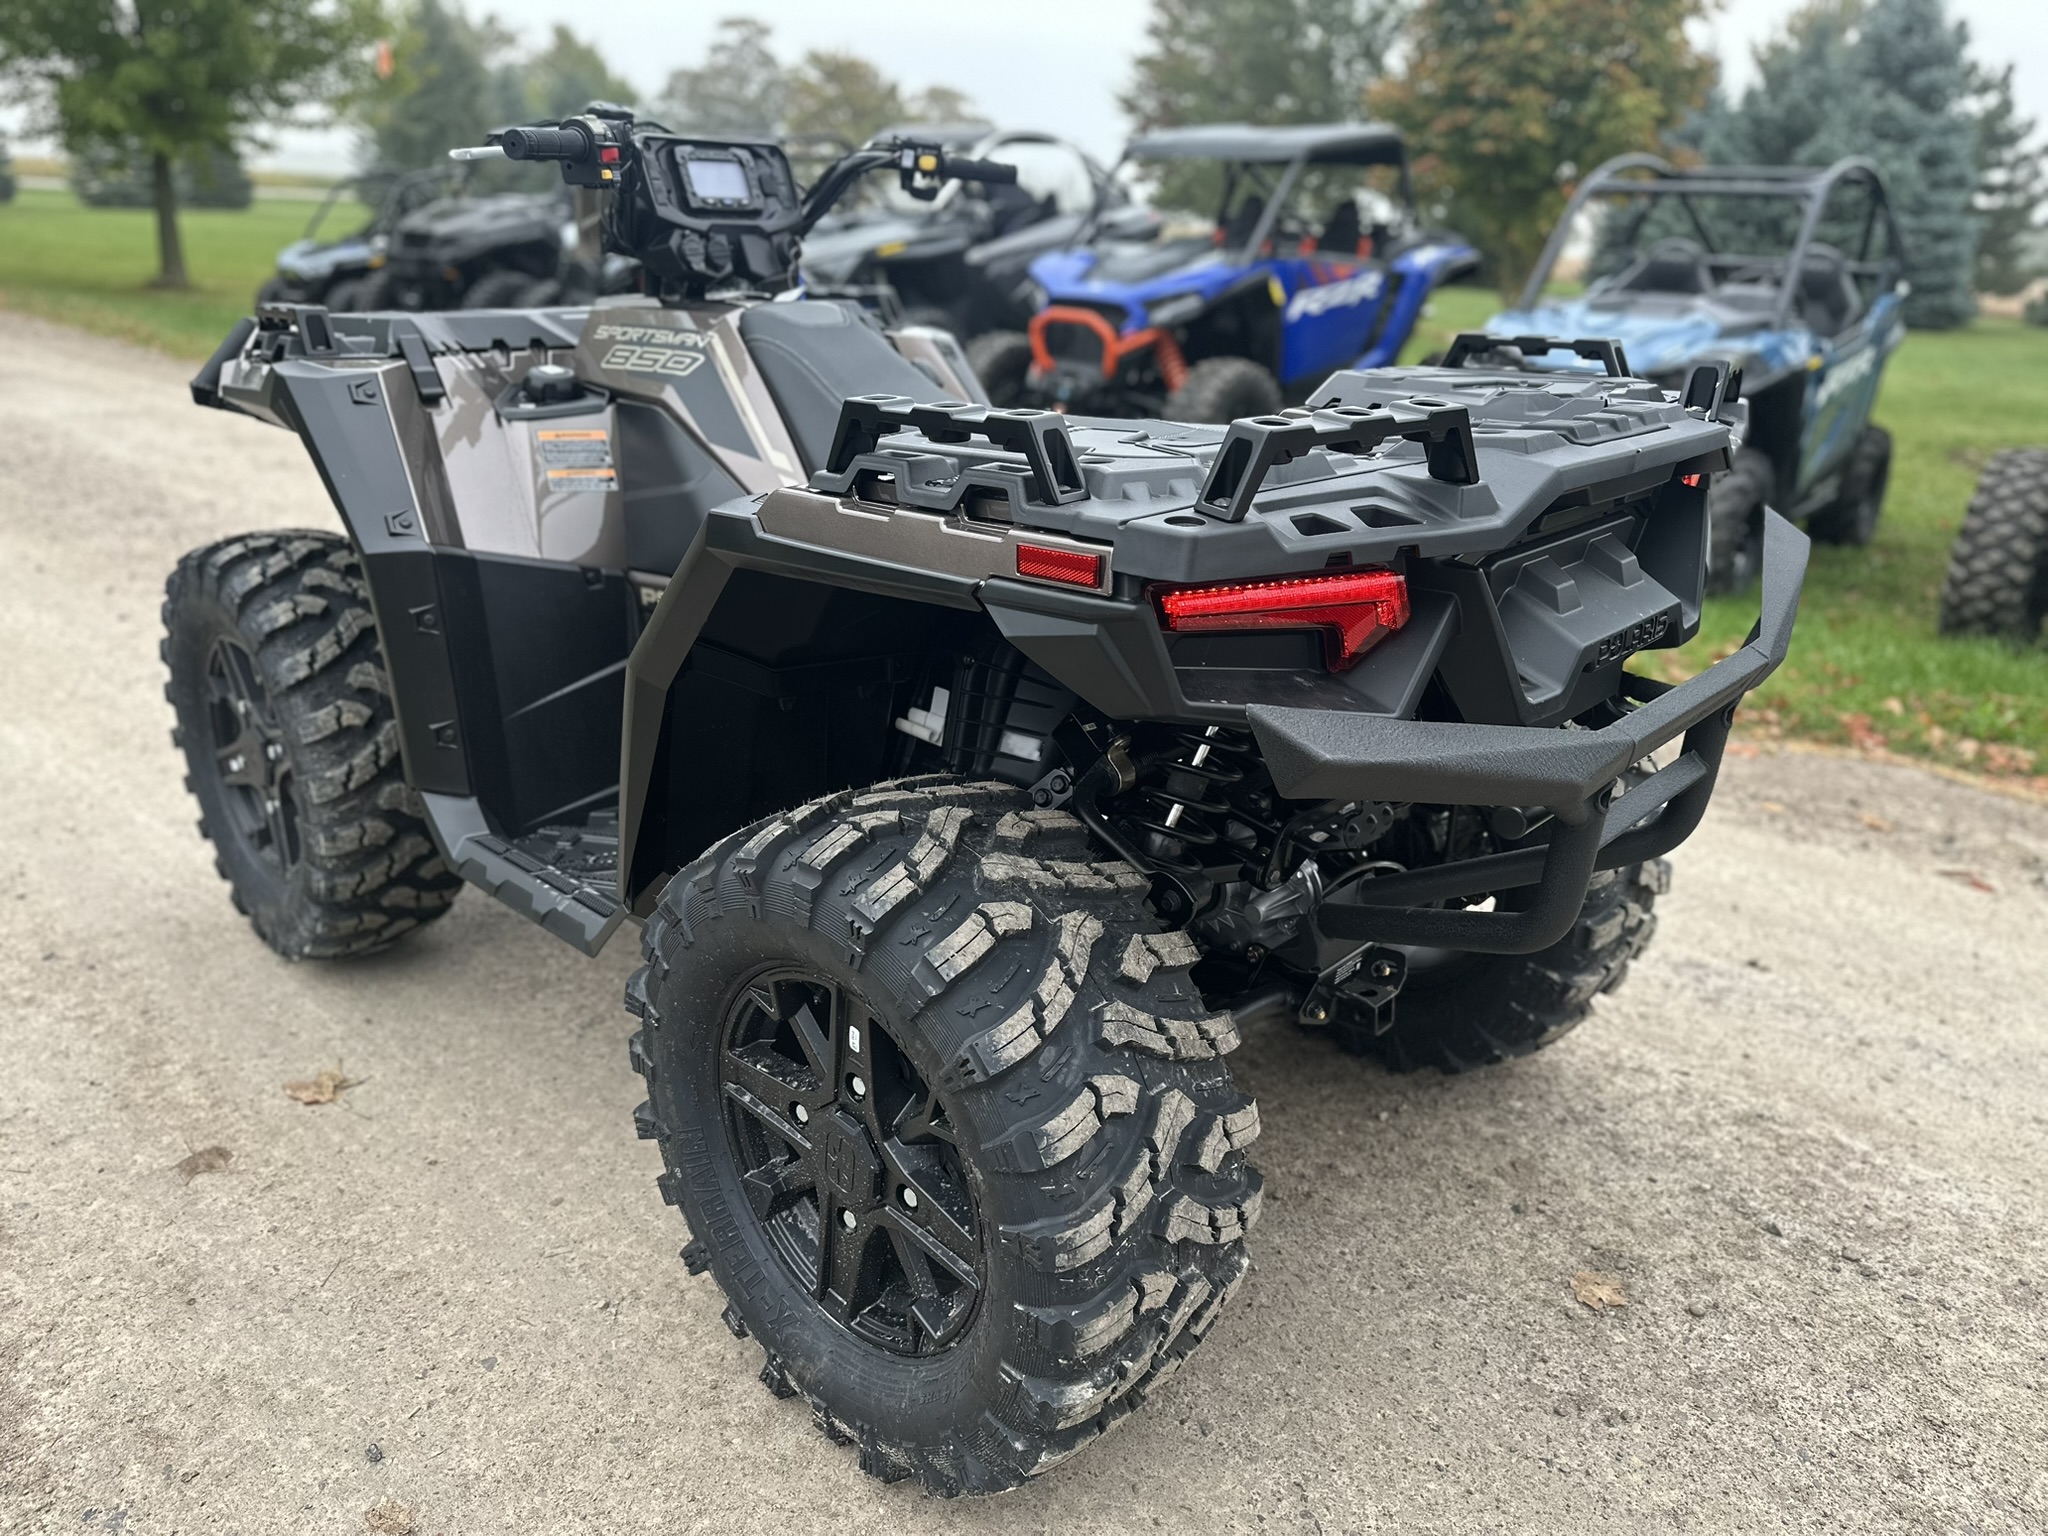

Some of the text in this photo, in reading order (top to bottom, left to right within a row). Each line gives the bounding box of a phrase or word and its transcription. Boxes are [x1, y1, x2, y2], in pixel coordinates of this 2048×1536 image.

[593, 325, 714, 348] SPORTSMAN
[601, 344, 705, 376] 850
[1595, 610, 1669, 669] POLARIS
[677, 1126, 800, 1343] X-TERRAIN
